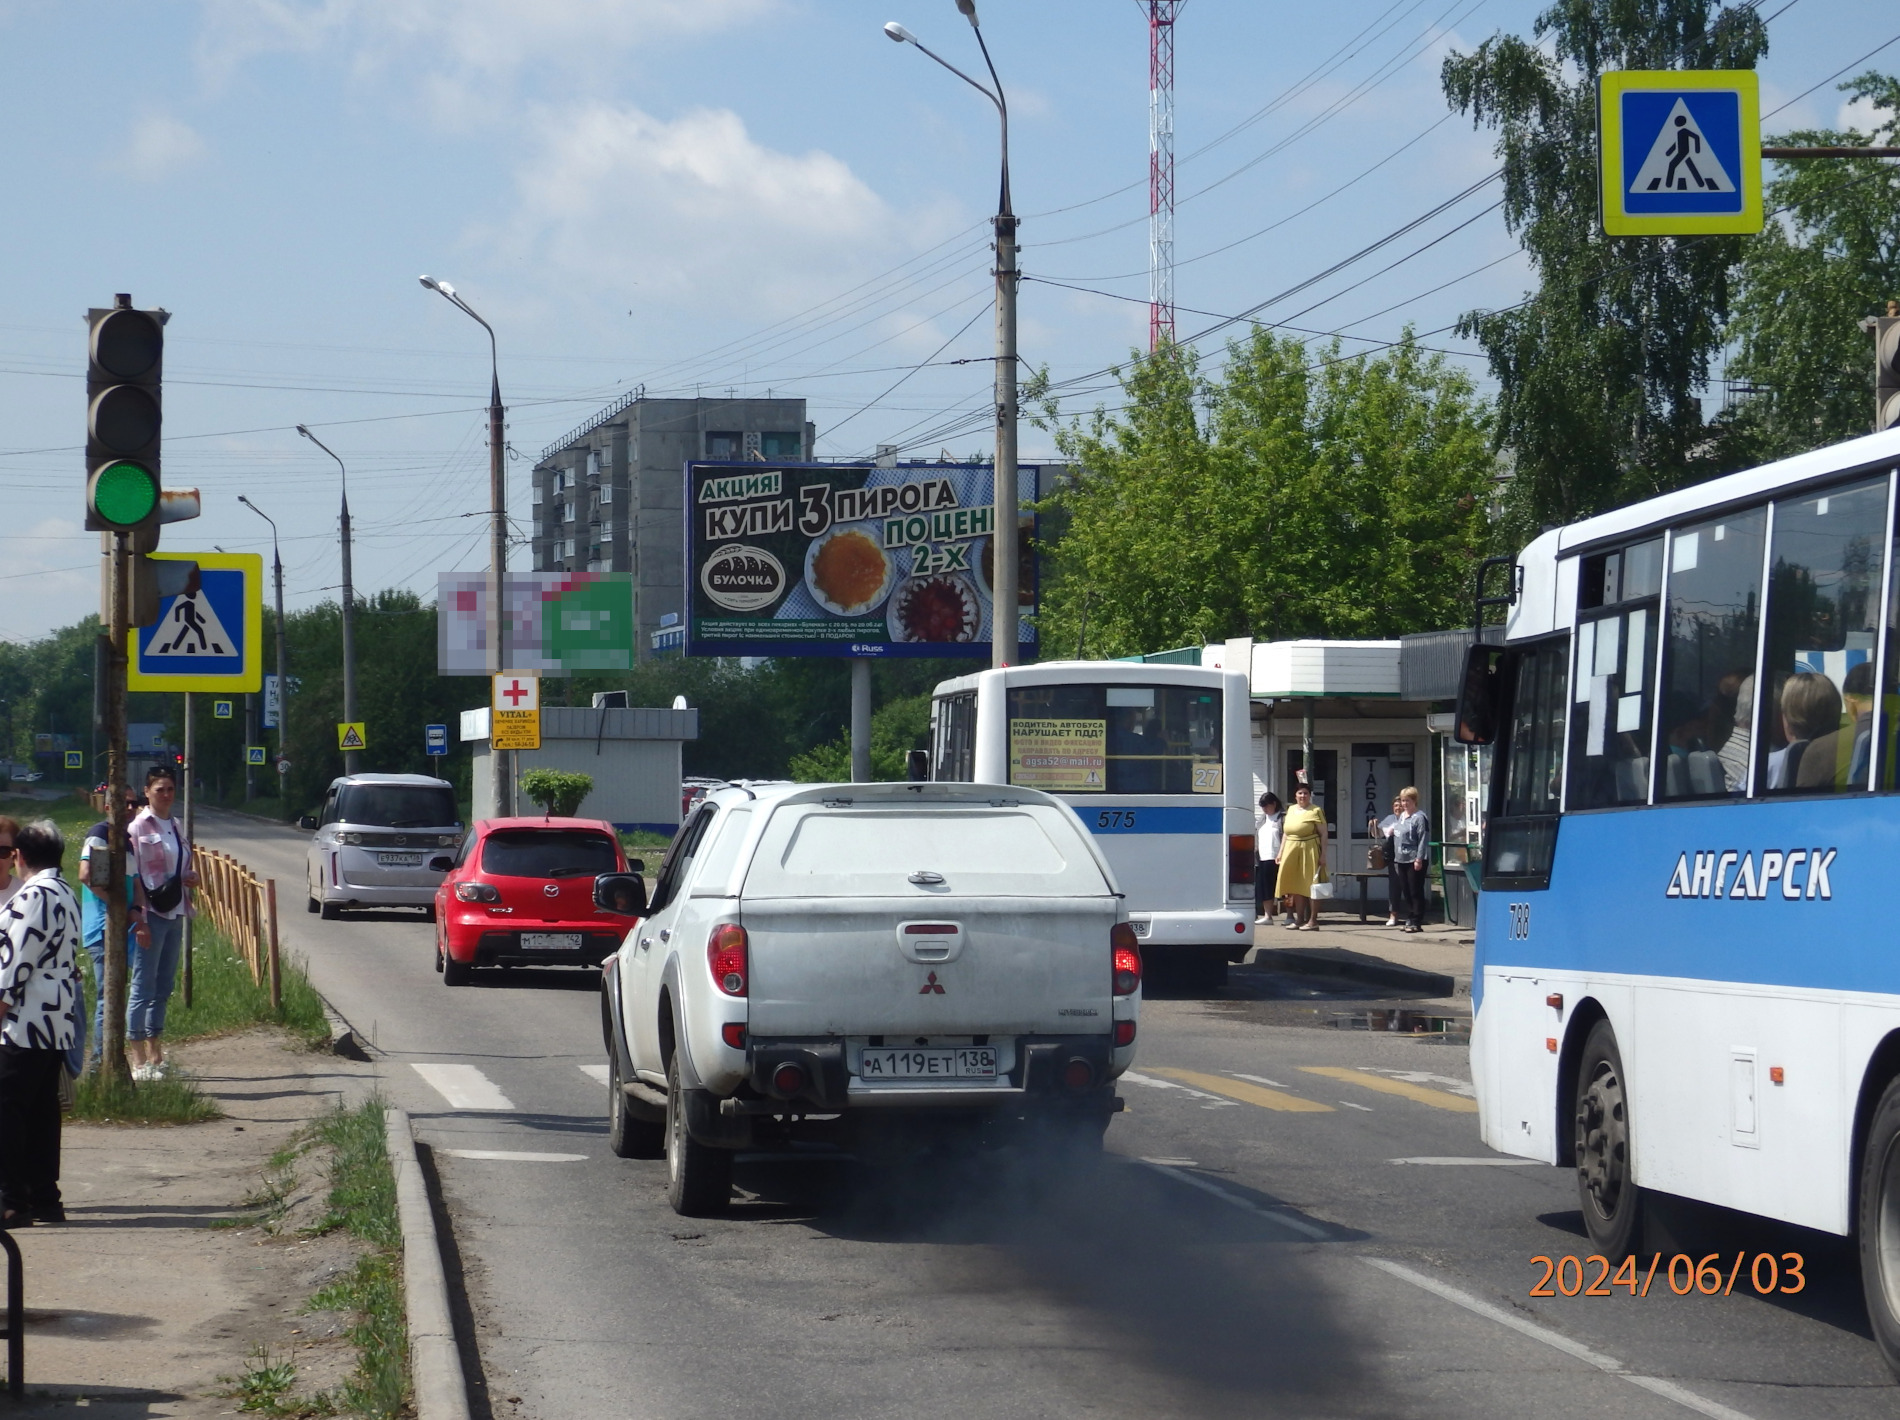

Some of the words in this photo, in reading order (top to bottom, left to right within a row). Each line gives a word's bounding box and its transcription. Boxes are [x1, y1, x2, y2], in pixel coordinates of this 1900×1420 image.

[701, 473, 780, 501] АКЦИЯ!
[707, 501, 792, 538] КУПИ
[800, 485, 830, 536] 3
[836, 479, 956, 520] ПИРОГА
[886, 516, 927, 545] ПО
[713, 574, 773, 585] БУЛОЧКА
[1012, 721, 1057, 729] ВОДИТЕЛЬ
[1012, 728, 1071, 737] НАРУШАЕТ
[1075, 729, 1104, 738] ПДД?
[1026, 756, 1102, 766] agsa52@mail.ru
[1194, 768, 1219, 787] 27
[1098, 811, 1135, 828] 575
[1666, 848, 1838, 900] АНГАРСК
[1509, 902, 1530, 941] 788
[871, 1053, 953, 1075] А119ЕТ
[959, 1051, 990, 1067] 138
